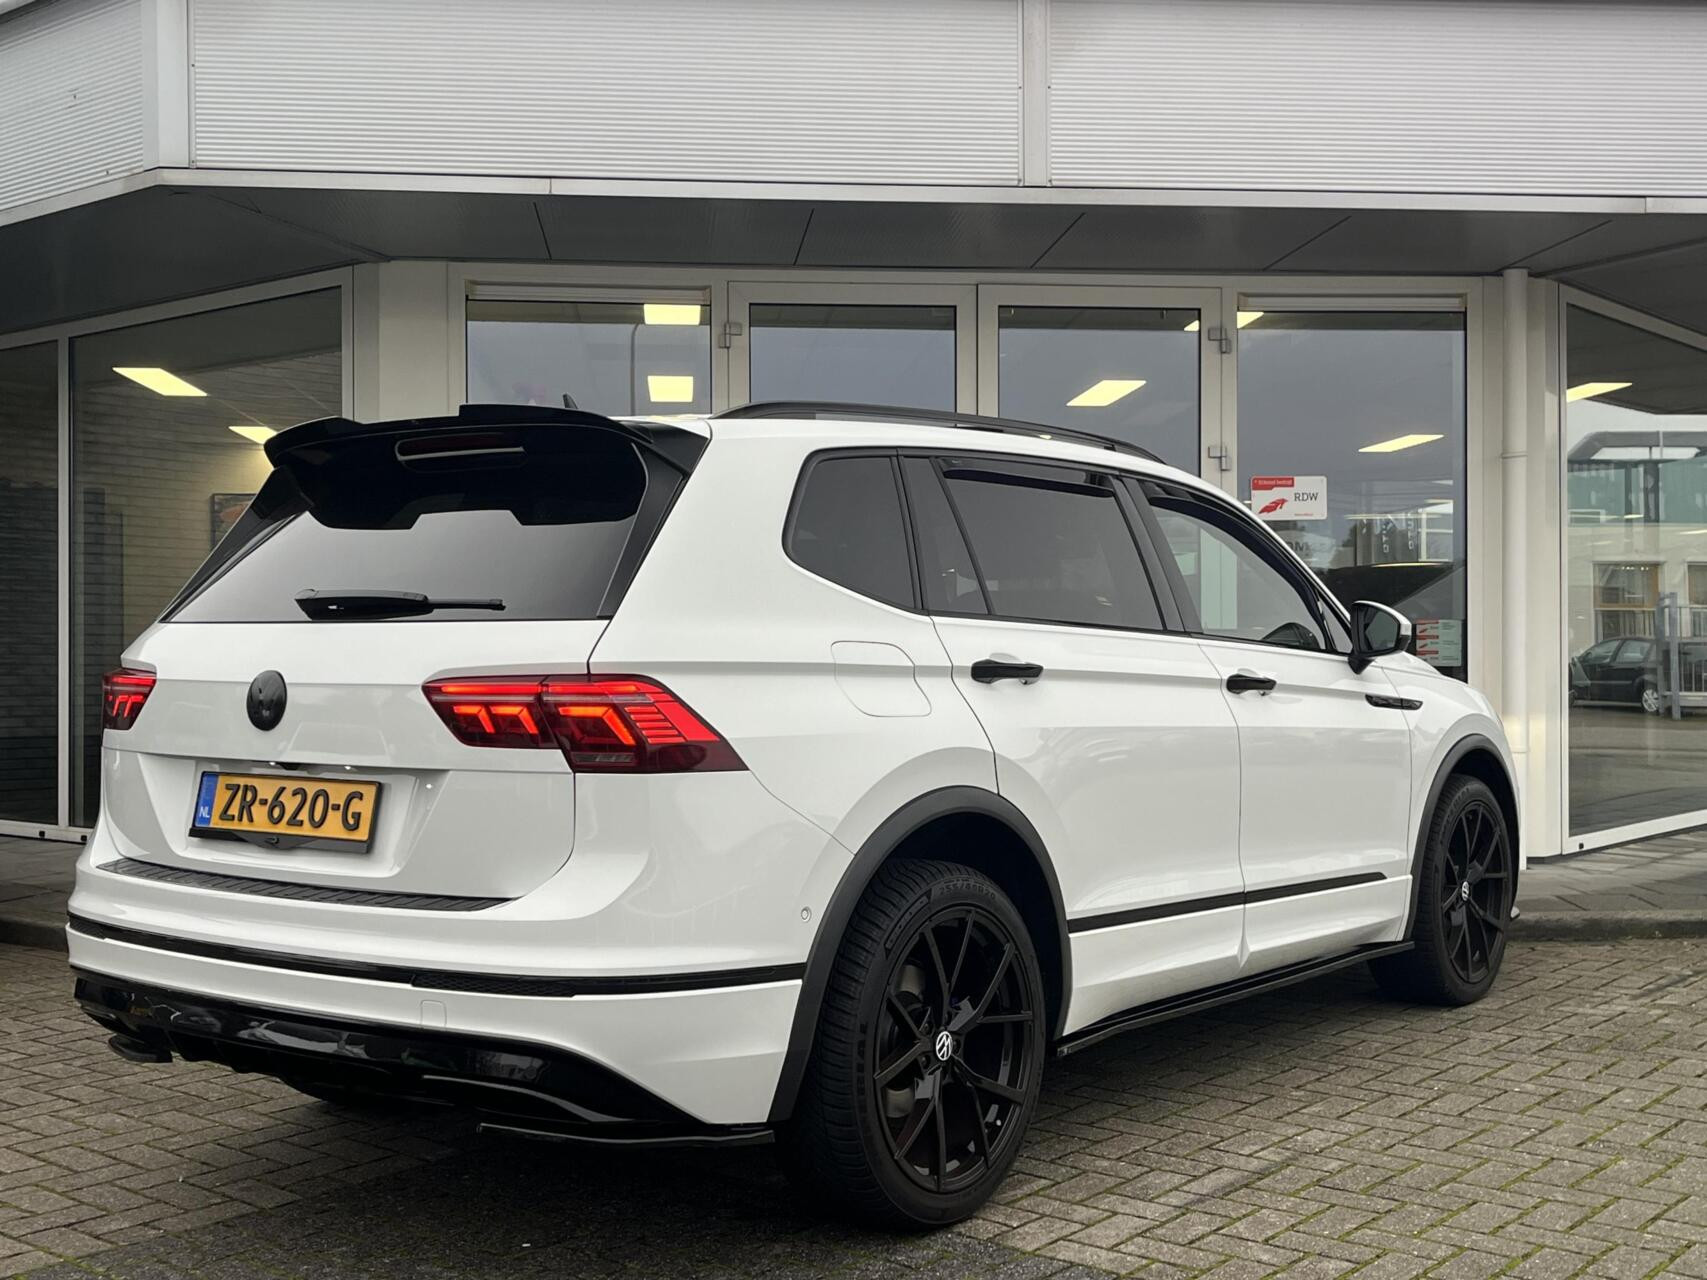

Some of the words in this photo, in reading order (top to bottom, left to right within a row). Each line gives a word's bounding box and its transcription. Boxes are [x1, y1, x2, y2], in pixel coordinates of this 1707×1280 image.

[1294, 492, 1318, 502] RDW
[199, 806, 210, 819] NL
[219, 783, 364, 832] ZR-620-G
